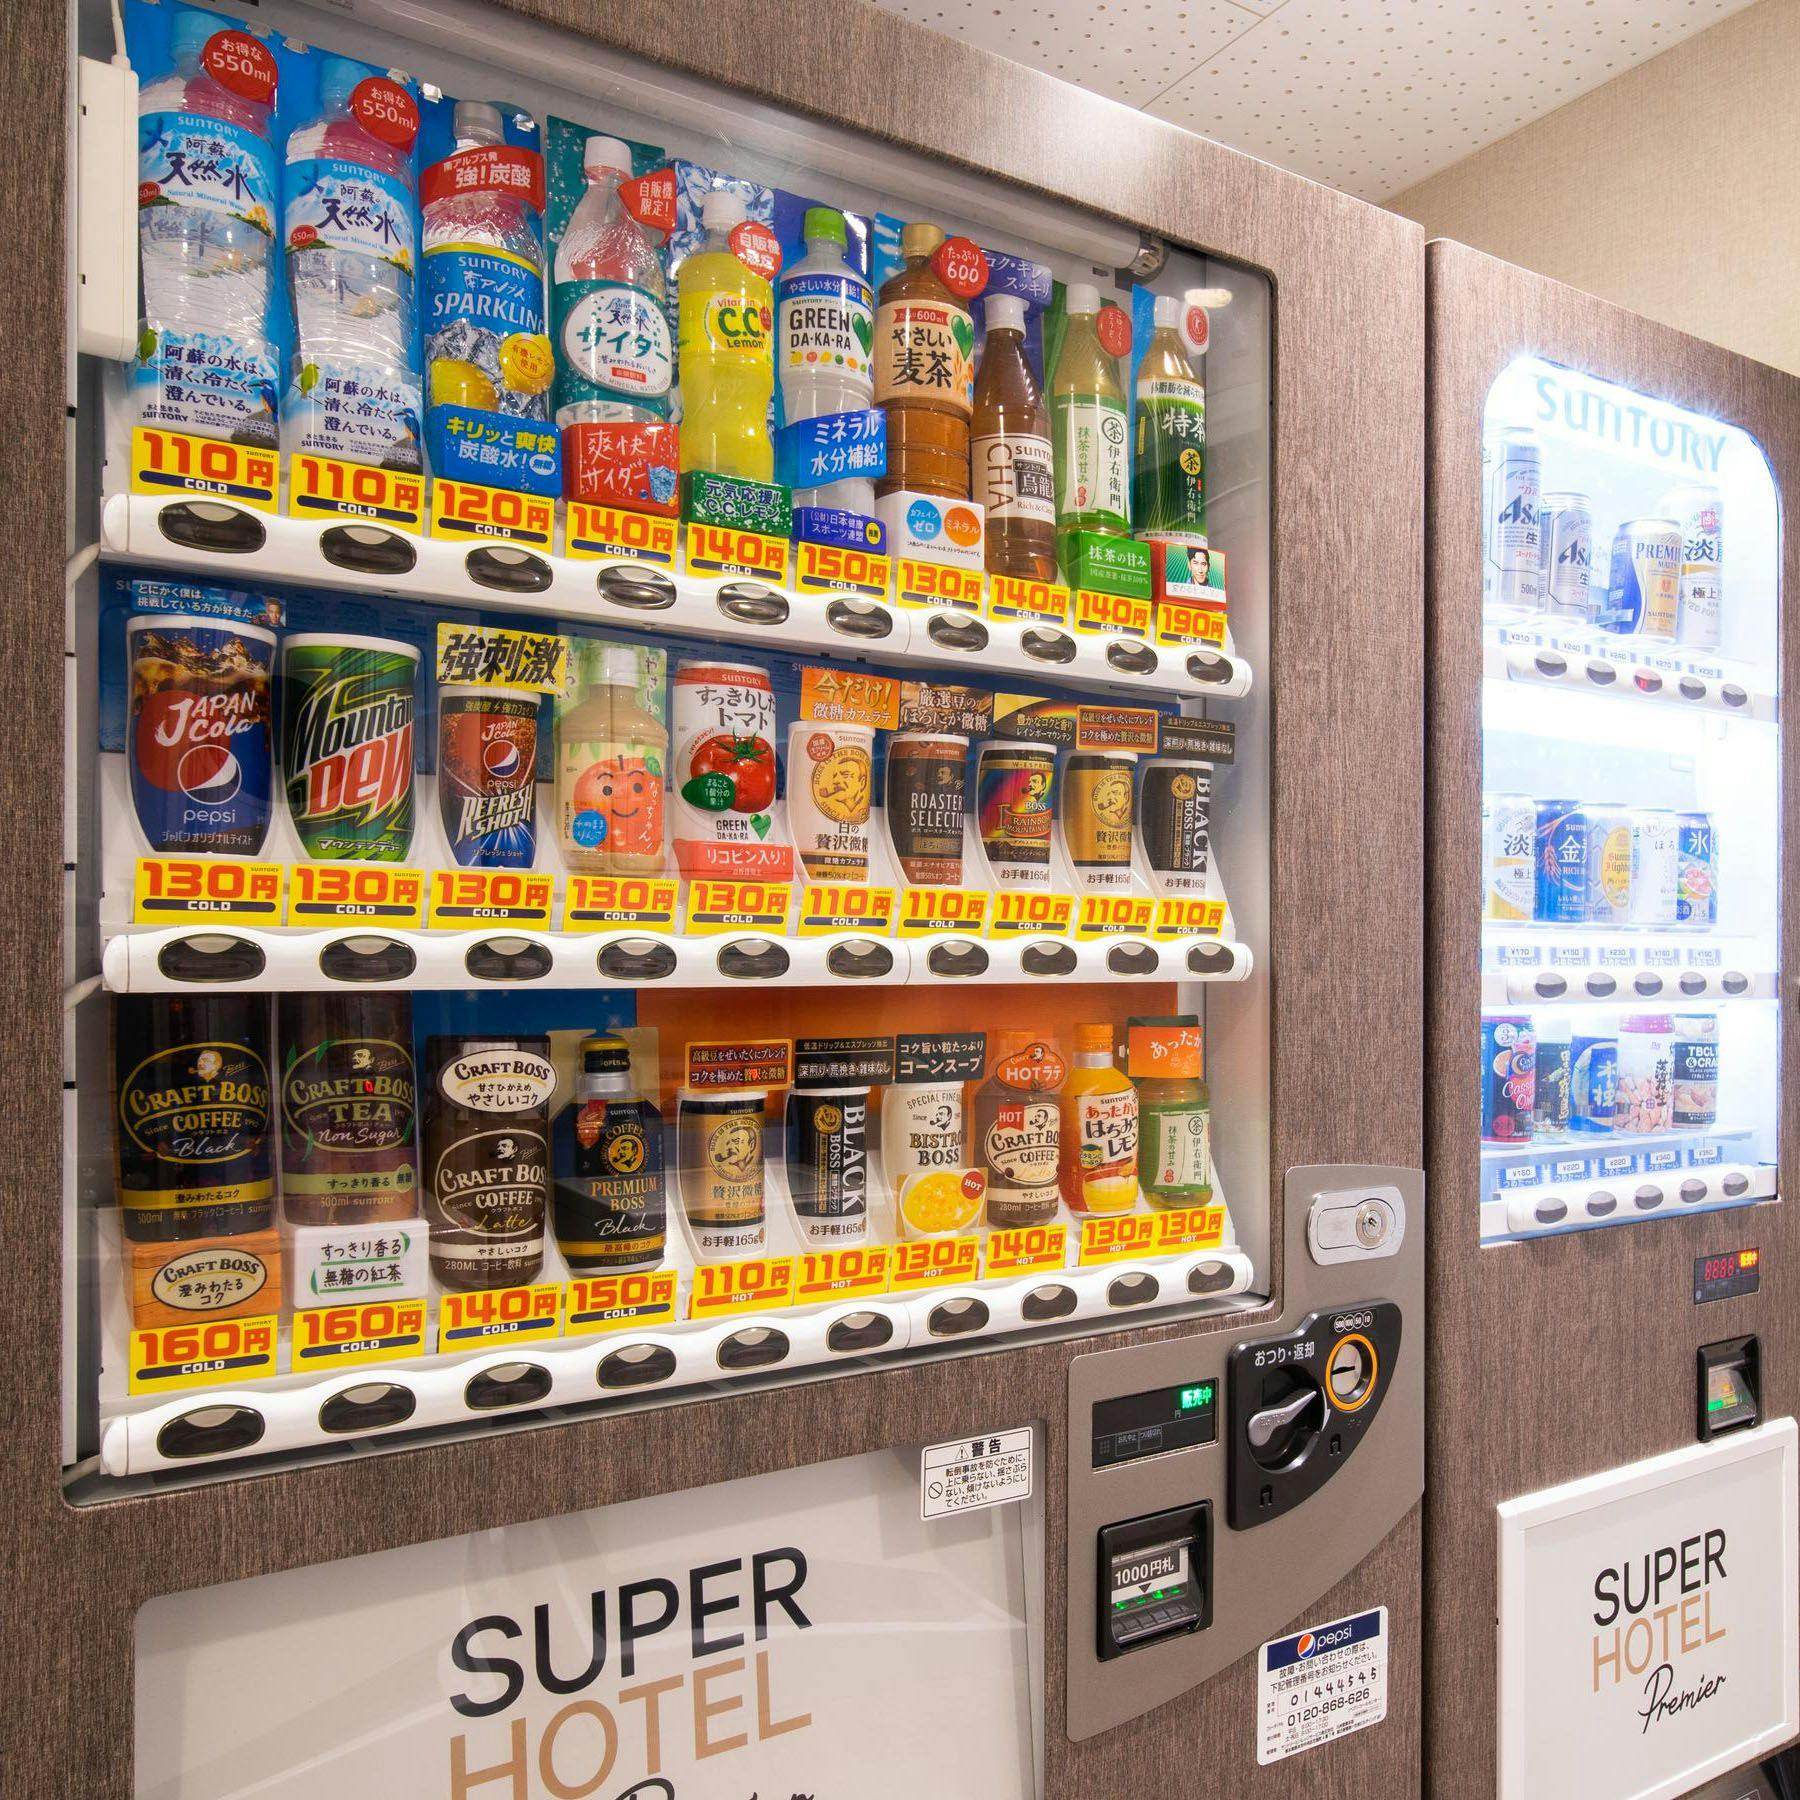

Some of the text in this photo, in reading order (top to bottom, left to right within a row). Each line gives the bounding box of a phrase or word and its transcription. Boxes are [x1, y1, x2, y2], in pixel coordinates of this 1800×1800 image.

[221, 38, 262, 61] お得な
[212, 51, 271, 83] 550ml
[371, 87, 407, 108] お得な
[177, 115, 239, 138] SUNTORY
[362, 101, 414, 130] 550ml
[158, 152, 257, 202] 天然水
[332, 163, 387, 185] SUNTORY
[315, 198, 402, 245] 天然水
[458, 255, 528, 281] SUNTORY
[946, 261, 980, 282] 600
[717, 307, 765, 338] C.C.
[789, 307, 850, 332] GREEN
[576, 326, 669, 363] サイダー
[726, 338, 764, 350] Lemon
[892, 325, 953, 349] やさしい
[165, 345, 265, 377] 阿蘇の水は、
[891, 350, 954, 389] 麦茶
[164, 365, 254, 394] 清く、冷たく、
[324, 377, 407, 406] 阿蘇の水は、
[165, 385, 252, 413] 澄んでいる。
[323, 397, 398, 422] 清く、冷たく、
[142, 412, 188, 423] SUNTORY
[323, 416, 397, 441] 澄んでいる。
[813, 413, 880, 445] ミネラル
[1536, 374, 1727, 473] SUNTORY
[301, 440, 344, 451] SUNTORY
[446, 416, 557, 455] キリッと爽快
[144, 432, 273, 487] 110円
[811, 442, 885, 477] 水分補給!
[302, 459, 419, 510] 110円
[580, 460, 649, 491] サイダー
[1108, 443, 1123, 510] 伊右衛門
[439, 483, 549, 531] 120円
[1186, 476, 1197, 524] 伊右衛門
[574, 504, 673, 551] 140円
[1525, 531, 1539, 546] 生
[691, 526, 784, 569] 140円
[1088, 545, 1148, 568] 抹茶の甘み
[805, 546, 886, 584] 150円
[829, 580, 857, 592] COLD
[903, 563, 980, 600] 130円
[994, 575, 1067, 613] 140円
[927, 596, 953, 607] COLD
[1016, 609, 1041, 620] COLD
[1082, 592, 1150, 626] 140円
[1100, 623, 1123, 633] COLD
[1163, 606, 1224, 638] 190円
[1181, 636, 1202, 645] COLD
[438, 633, 566, 683] 強刺激
[721, 673, 762, 686] SUNTORY
[813, 672, 893, 711] 今だけ!
[717, 707, 769, 731] トマト
[812, 702, 893, 724] 微糖カフェラテ
[486, 778, 517, 790] pepsi
[183, 808, 236, 824] pepsi
[1024, 801, 1046, 811] BOSS
[1183, 799, 1195, 832] BOSS
[716, 819, 748, 832] GREEN
[1192, 775, 1211, 869] BLACK
[1688, 832, 1709, 855] 氷
[143, 862, 277, 899] 130円
[297, 868, 418, 903] 130円
[438, 874, 548, 906] 130円
[573, 879, 673, 910] 130円
[696, 883, 786, 913] 130円
[811, 889, 890, 916] 110円
[910, 892, 984, 918] 110円
[1001, 895, 1069, 920] 110円
[1088, 899, 1150, 922] 110円
[1164, 902, 1221, 924] 110円
[692, 1046, 786, 1063] 高級豆をぜいたくにブレンド
[900, 1039, 984, 1056] コク旨い粒たっぷり
[453, 1060, 551, 1082] CRAFT BOSS
[900, 1056, 984, 1075] コーンスープ
[467, 1093, 539, 1107] やさしいコク
[478, 1082, 532, 1092] 甘さひかえめ
[172, 1111, 242, 1131] COFFEE
[328, 1102, 392, 1124] TEA
[999, 1110, 1023, 1123] HOT
[829, 1133, 841, 1169] BOSS
[842, 1103, 866, 1213] BLACK
[918, 1149, 960, 1167] BOSS
[1019, 1150, 1056, 1165] COFFEE
[475, 1190, 534, 1209] COFFEE
[591, 1178, 658, 1198] PREMIUM
[610, 1196, 646, 1211] BOSS
[1087, 1219, 1152, 1246] 130円
[1161, 1210, 1221, 1236] 130円
[321, 1238, 403, 1260] すっきり香る
[477, 1244, 529, 1256] やさしいコク
[897, 1241, 975, 1272] 130円
[992, 1230, 1063, 1258] 140円
[162, 1256, 260, 1285] CRAFT BOSS
[323, 1264, 403, 1288] 無糖の紅茶
[445, 1259, 522, 1272] 280ML コーヒー飲料
[701, 1263, 789, 1294] 110円
[804, 1252, 885, 1282] 110円
[178, 1278, 244, 1299] 澄みわたる
[199, 1292, 224, 1308] コク
[573, 1276, 672, 1311] 150円
[732, 1292, 754, 1302] HOT
[447, 1290, 556, 1327] 140円
[603, 1307, 637, 1319] COLD
[303, 1306, 422, 1344] 160円
[138, 1322, 271, 1366] 160円
[1254, 1341, 1316, 1367] おつり・返却
[1182, 1386, 1212, 1408] 販売中
[972, 1438, 1001, 1458] 警告
[945, 1454, 1027, 1478] 転倒事故を防ぐために、
[945, 1463, 1028, 1488] 上に乗らない、揺さぶら
[945, 1473, 1028, 1498] ない、傾けないようにし
[945, 1494, 987, 1507] てください。
[1115, 1556, 1175, 1585] 1000円札
[1593, 1528, 1727, 1627] SUPER
[449, 1547, 813, 1718] SUPER
[1317, 1624, 1353, 1650] pepsi
[1593, 1591, 1727, 1693] HOTEL
[1270, 1653, 1378, 1694] 下記管理番号をお知らせください。
[1279, 1643, 1371, 1678] 故障・お問い合わせの際は、
[1288, 1687, 1371, 1727] 0120-868-626
[1638, 1663, 1727, 1735] Premier
[449, 1651, 813, 1800] HOTEL
